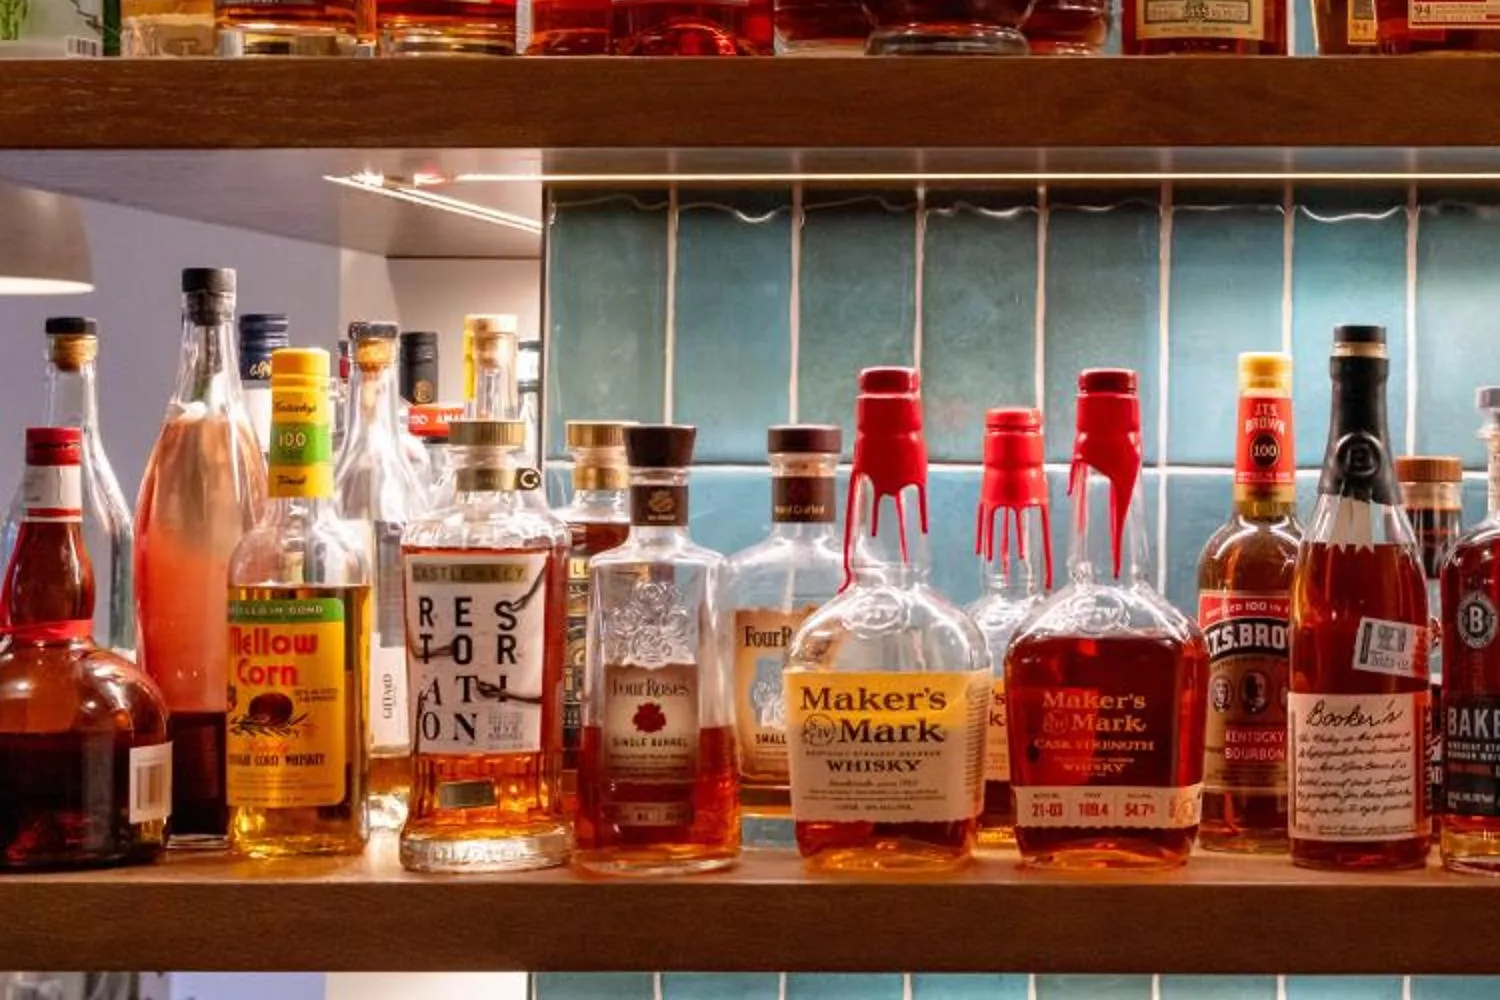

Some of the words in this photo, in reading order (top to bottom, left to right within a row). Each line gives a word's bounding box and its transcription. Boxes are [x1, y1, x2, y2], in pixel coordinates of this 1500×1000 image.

[1244, 417, 1287, 437] BROWN
[278, 432, 307, 447] 100
[1252, 444, 1278, 458] 100
[1245, 601, 1267, 612] 100
[1468, 606, 1484, 632] B
[230, 627, 319, 656] Mellow
[237, 658, 298, 686] Corn
[647, 678, 690, 697] Roses
[800, 686, 947, 711] Maker's
[1042, 690, 1147, 710] Maker's
[1306, 698, 1404, 727] Booker's
[838, 718, 946, 744] Mark
[1071, 713, 1148, 733] Mark
[611, 736, 647, 748] SINGLE
[755, 733, 788, 745] SMALL
[1225, 730, 1285, 744] KENTUCKY
[1225, 747, 1286, 761] BOURBON
[826, 759, 922, 773] WHISKY
